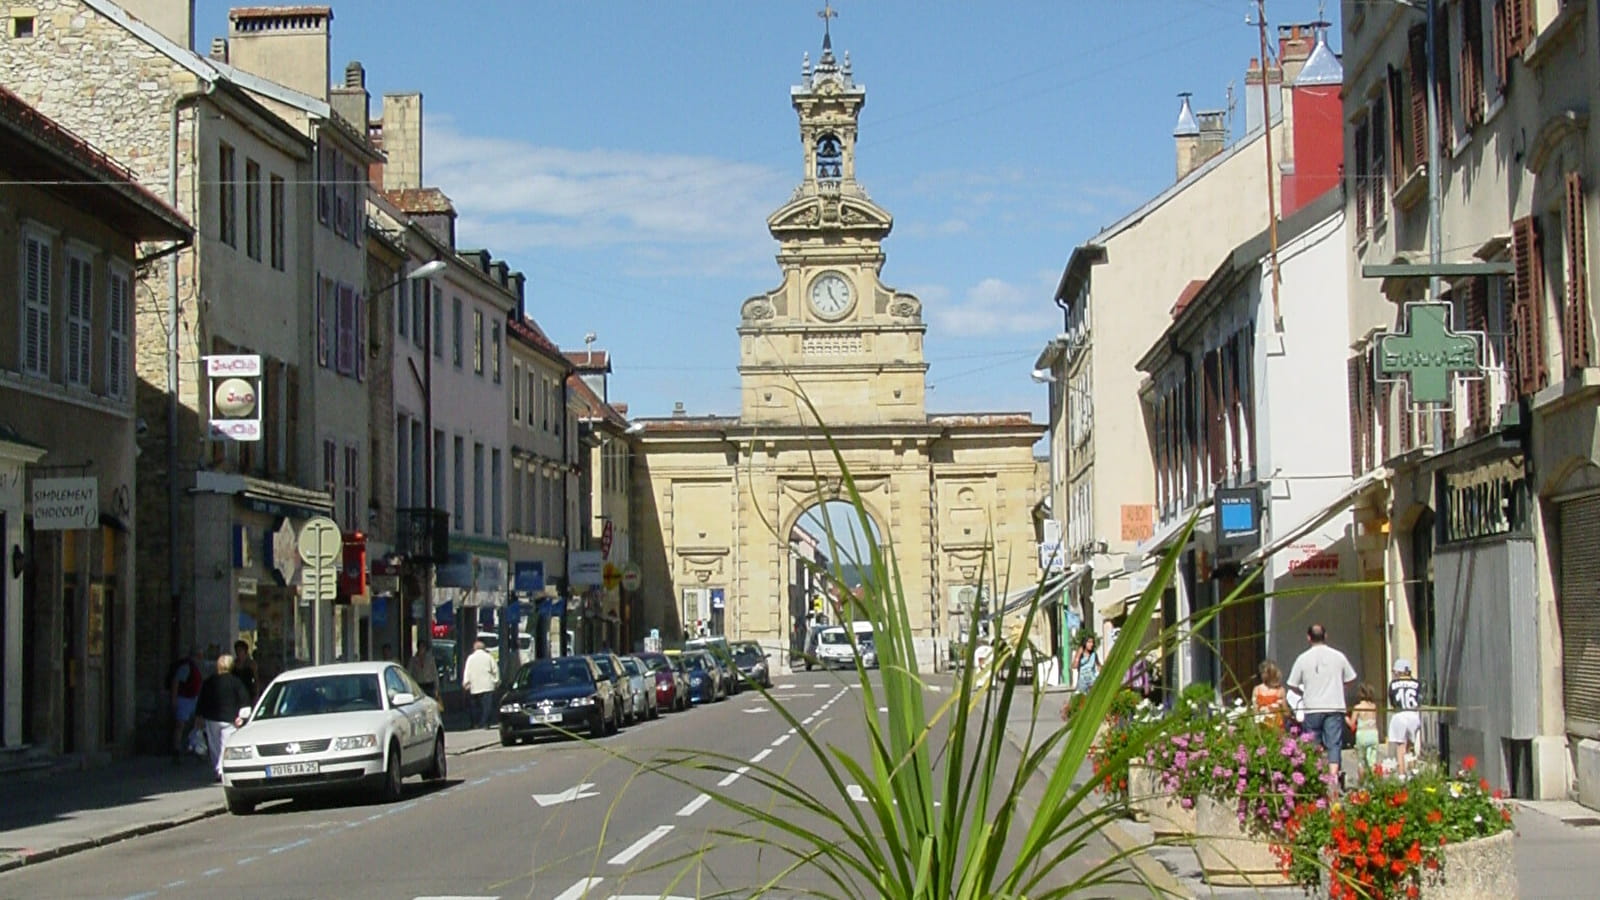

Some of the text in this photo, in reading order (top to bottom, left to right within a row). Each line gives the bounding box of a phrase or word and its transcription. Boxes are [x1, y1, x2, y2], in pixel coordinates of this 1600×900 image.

[34, 488, 94, 500] SIMPLEMENT
[34, 504, 84, 518] CHOCOLAT
[1396, 688, 1418, 709] 16
